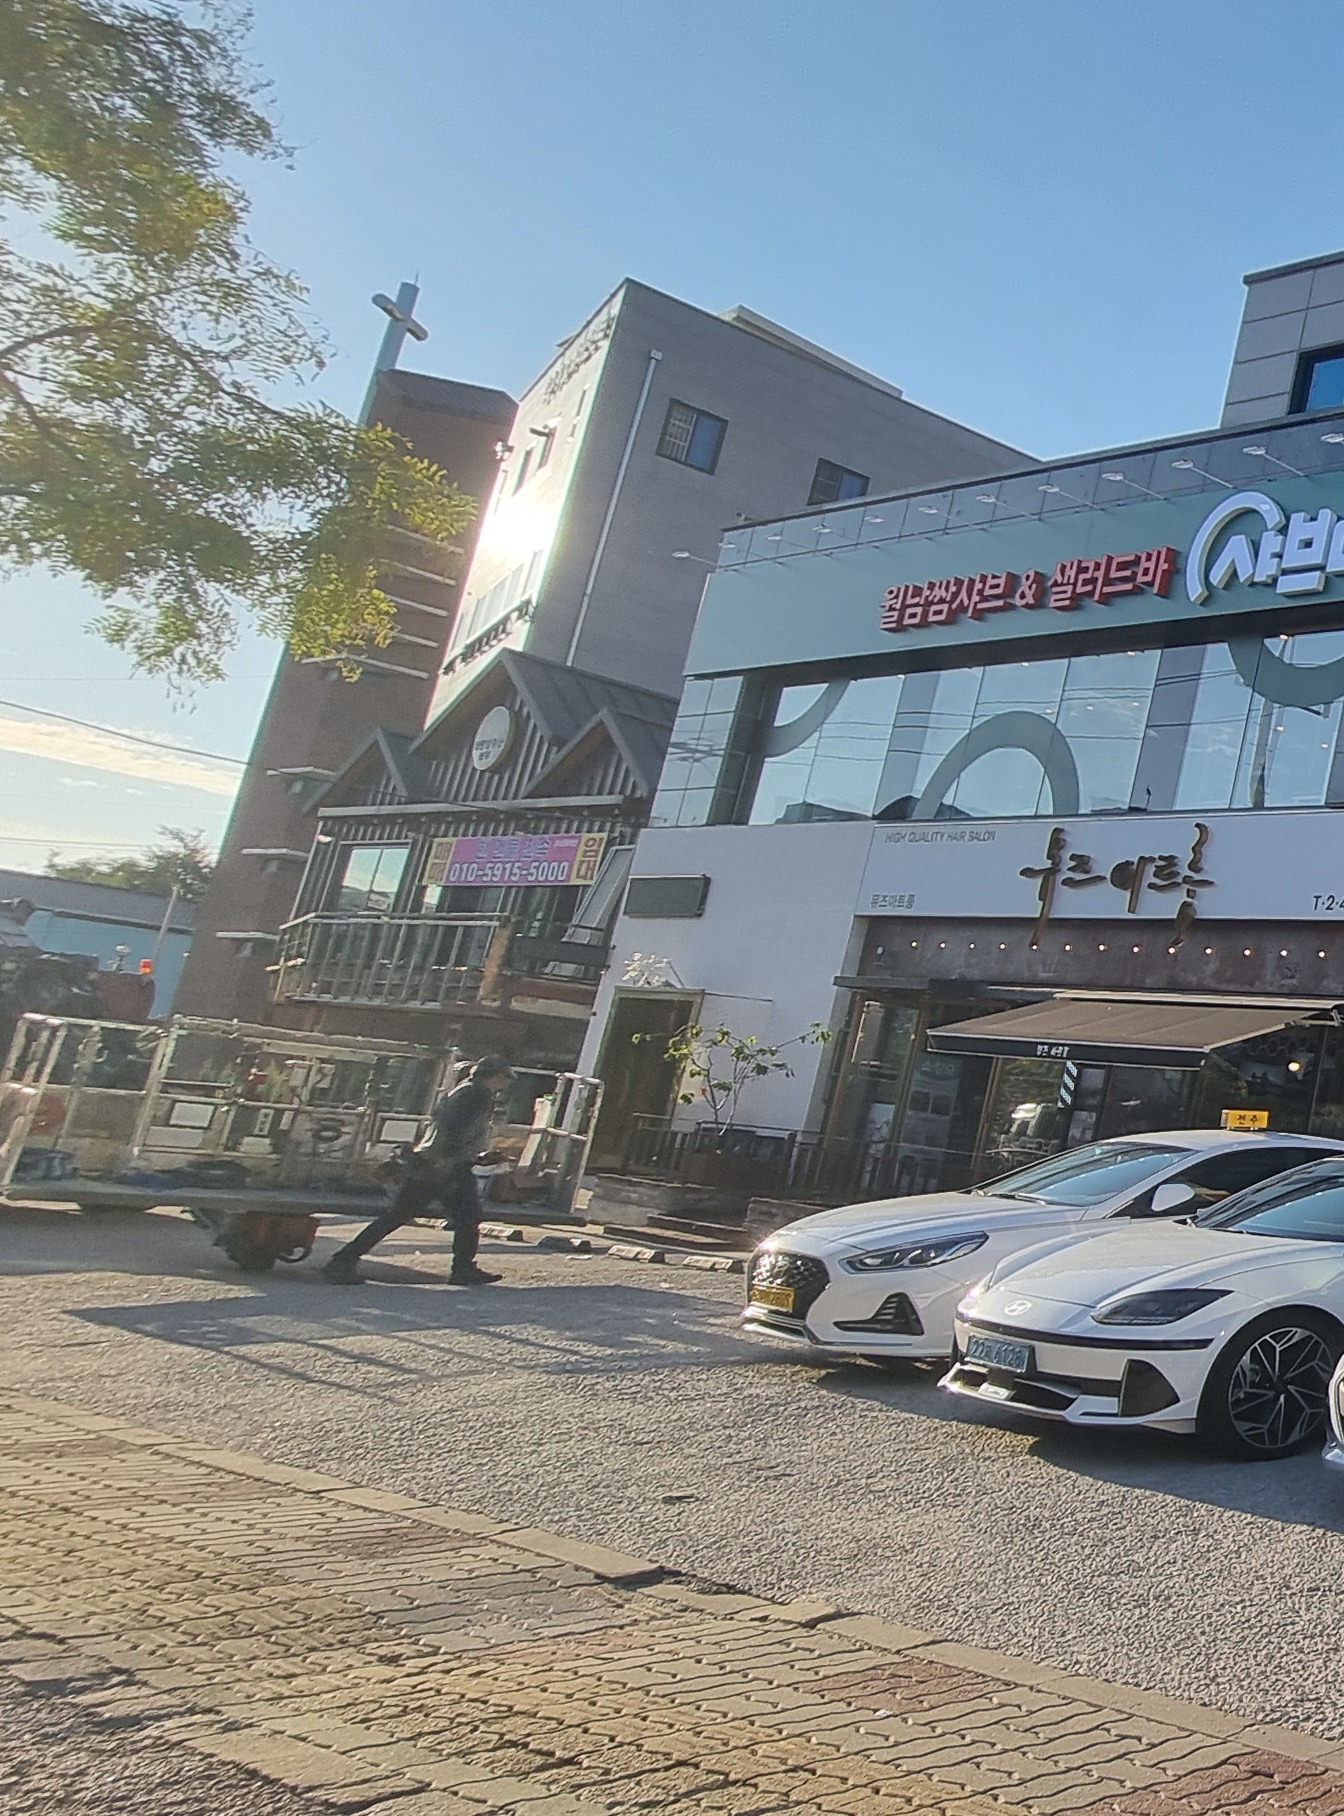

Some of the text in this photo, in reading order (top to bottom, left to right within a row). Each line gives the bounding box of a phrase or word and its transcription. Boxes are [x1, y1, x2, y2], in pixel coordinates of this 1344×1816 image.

[879, 545, 1177, 629] 월남쌈샤브 & 샐러드바
[908, 831, 945, 843] QUALITY
[946, 831, 966, 842] HAIR
[967, 830, 996, 843] SALON
[450, 861, 569, 882] 010-5915-5000
